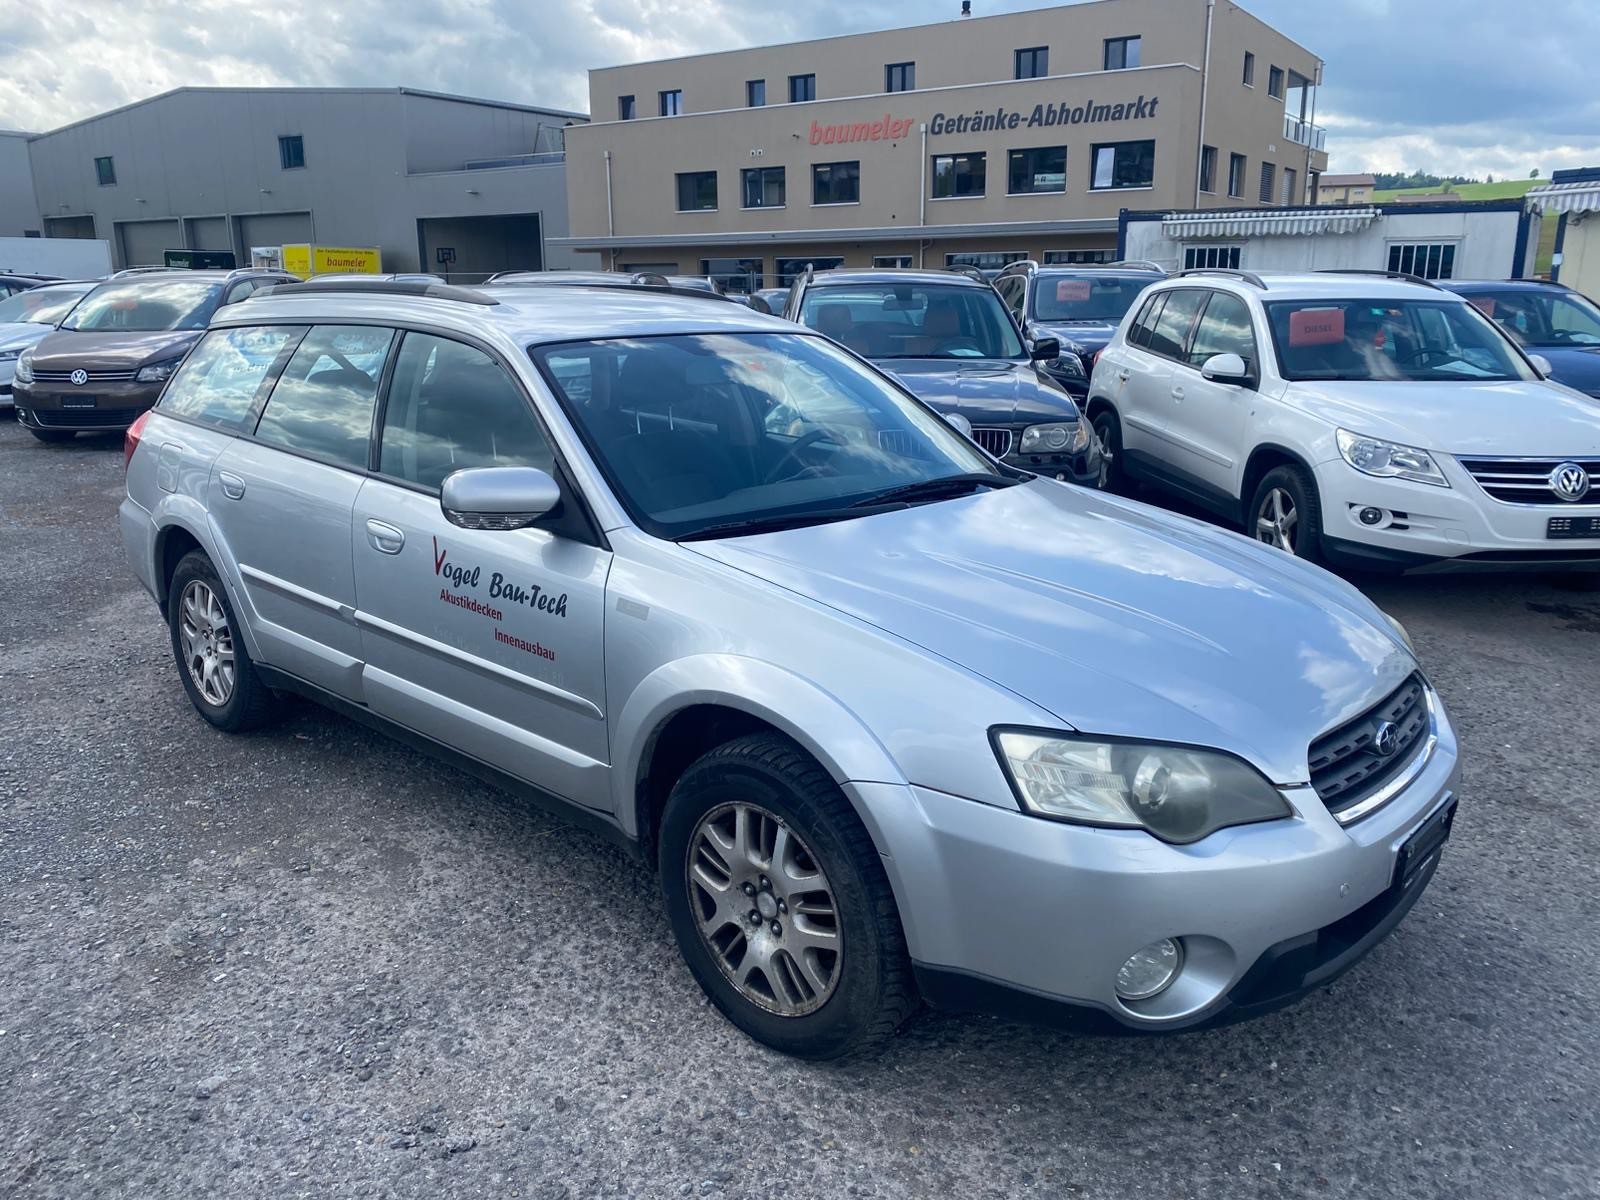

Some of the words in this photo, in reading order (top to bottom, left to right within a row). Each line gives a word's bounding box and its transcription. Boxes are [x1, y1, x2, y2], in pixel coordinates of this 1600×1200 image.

[809, 113, 914, 145] baumeler
[930, 96, 1159, 136] Getränke-Abholmarkt
[327, 256, 366, 267] baumeler
[1304, 323, 1334, 333] DIESEL
[432, 535, 480, 588] Vogel
[440, 588, 502, 621] Akustikdecken
[494, 627, 555, 661] Innenausbau
